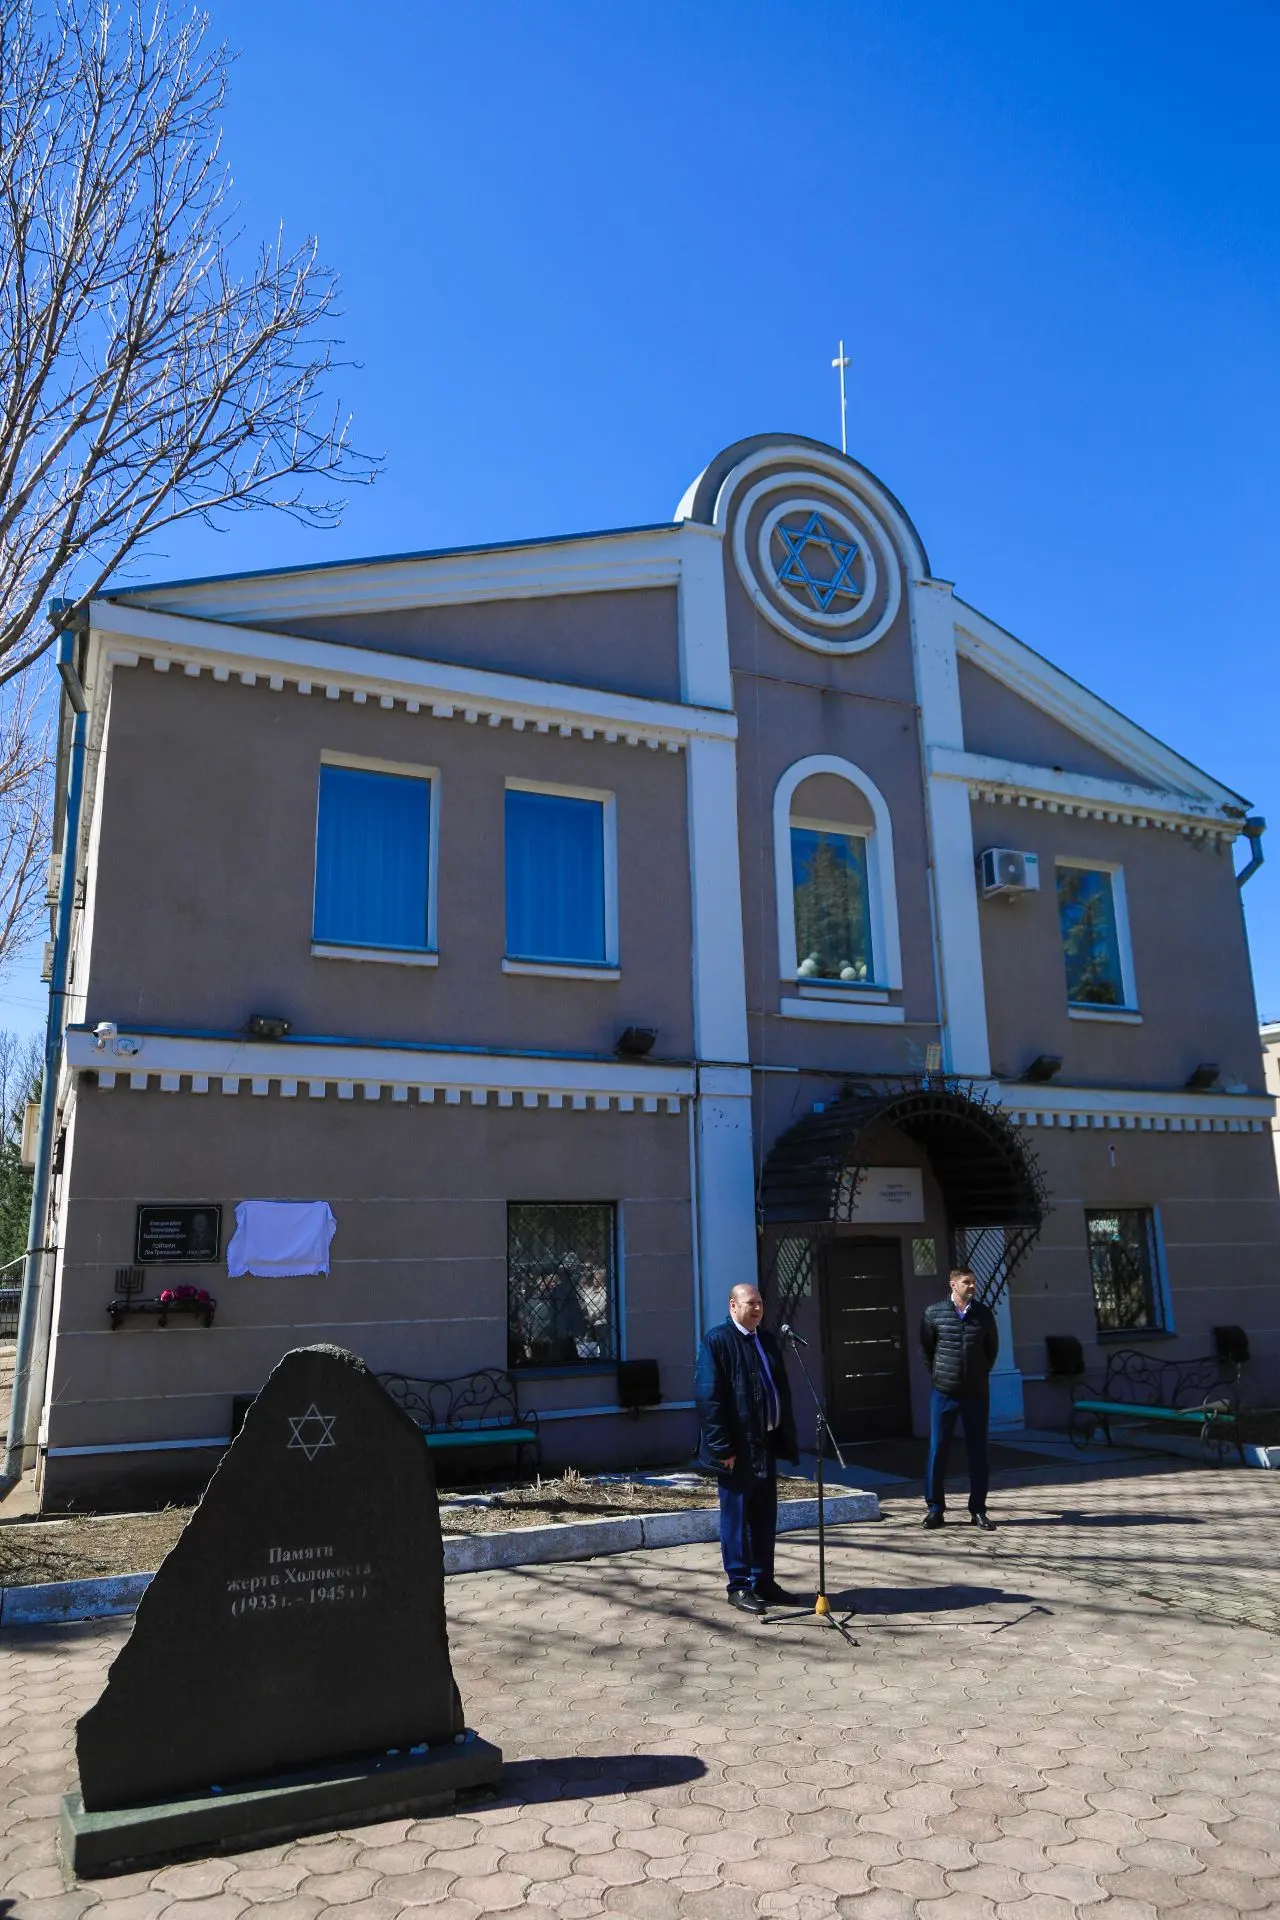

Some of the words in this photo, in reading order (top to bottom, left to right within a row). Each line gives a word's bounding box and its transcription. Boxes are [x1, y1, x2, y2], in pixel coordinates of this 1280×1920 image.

[268, 1545, 334, 1564] Памяти
[227, 1574, 280, 1593] жертв
[284, 1562, 372, 1584] Холокоста
[309, 1584, 346, 1605] 1945
